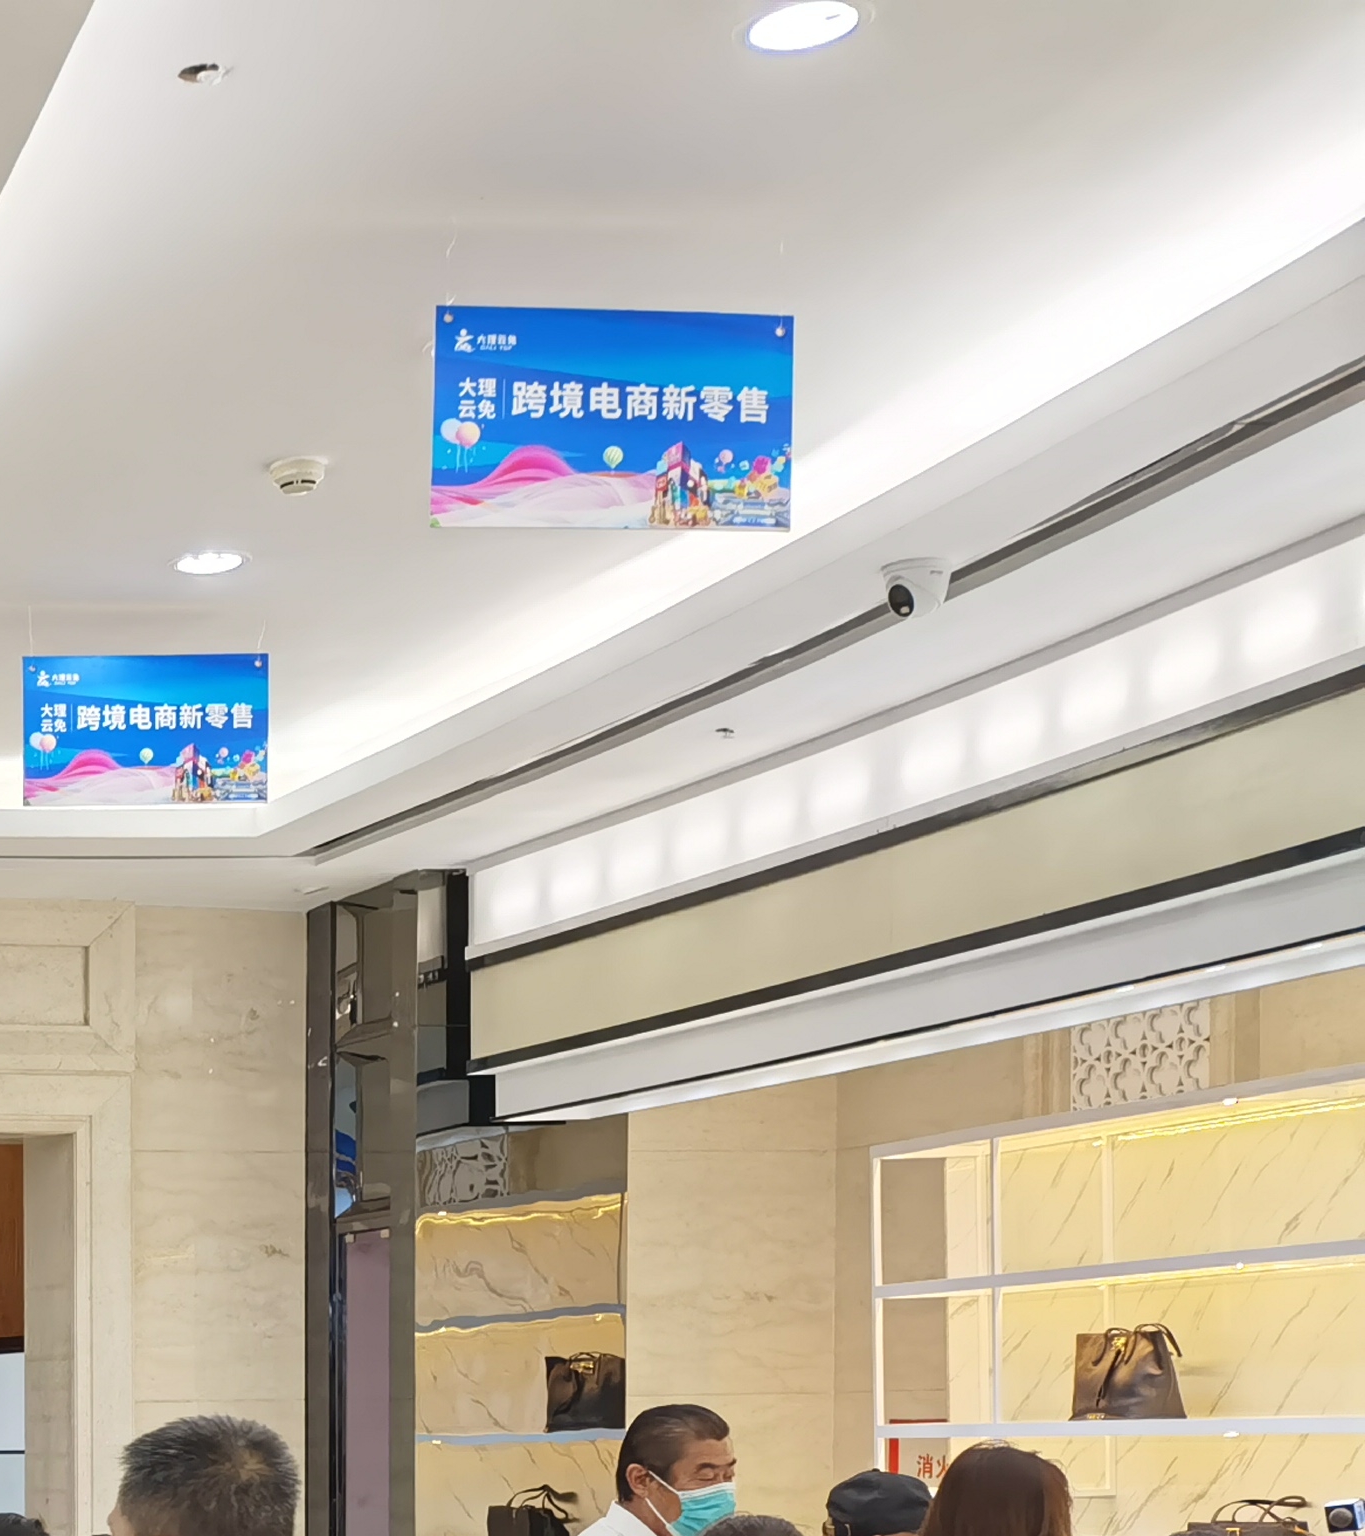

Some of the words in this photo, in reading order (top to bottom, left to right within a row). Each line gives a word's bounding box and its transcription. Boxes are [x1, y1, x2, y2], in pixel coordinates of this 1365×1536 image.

[458, 376, 497, 398] 大理
[458, 398, 497, 420] 云免
[510, 381, 769, 424] 跨境电商新零售
[40, 703, 67, 718] 大理
[76, 702, 254, 731] 跨境电商新零售
[40, 719, 67, 733] 云免
